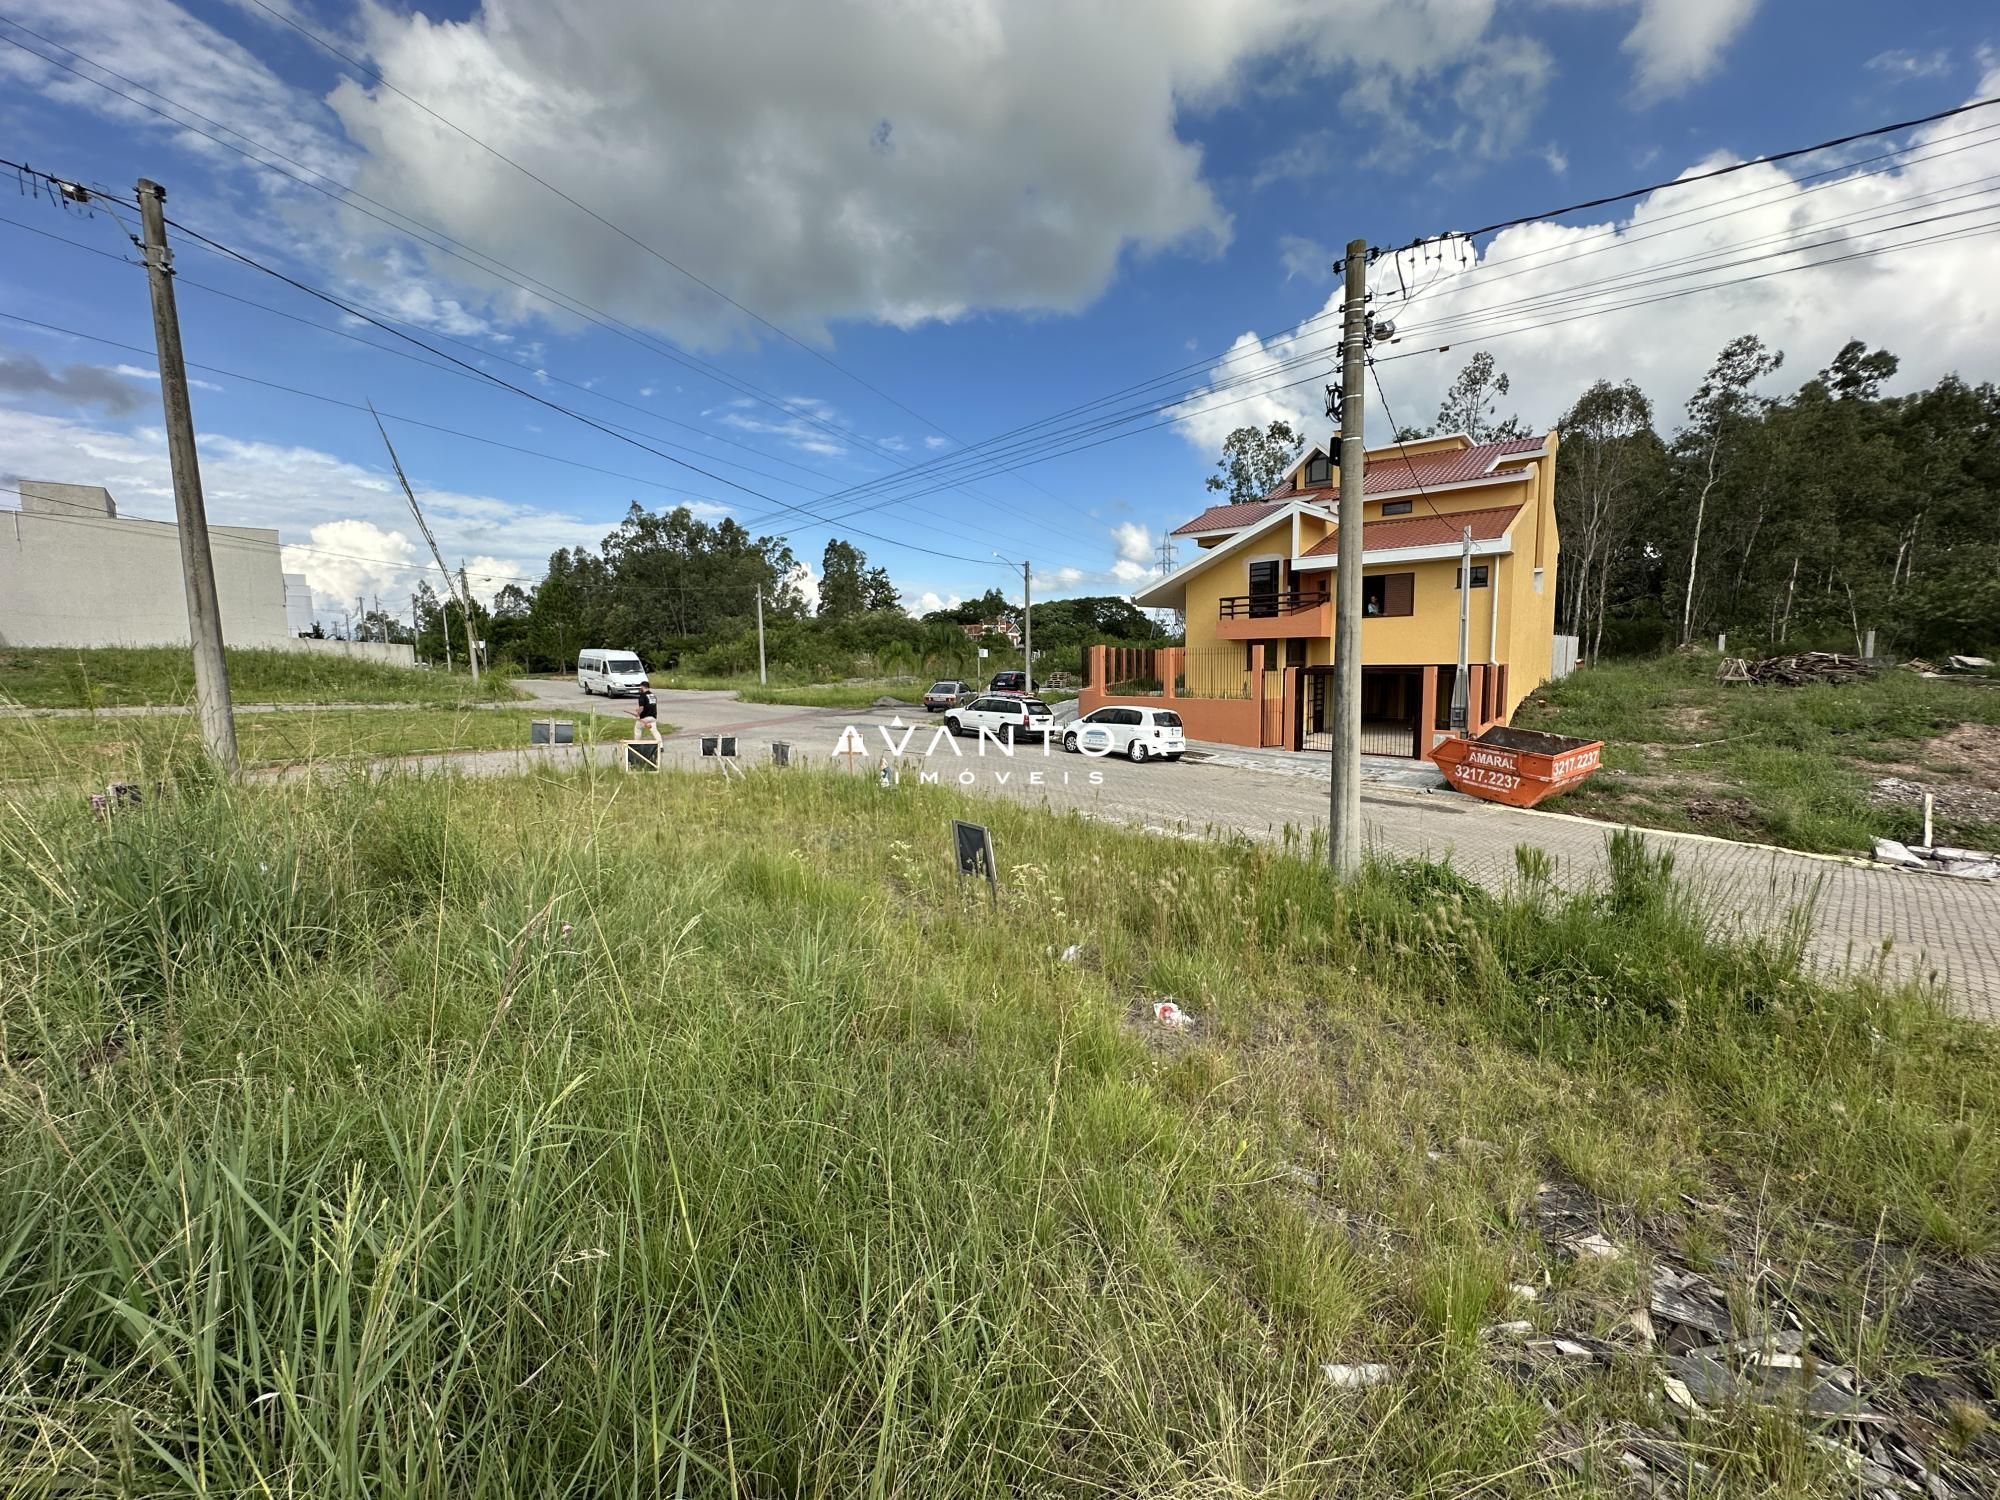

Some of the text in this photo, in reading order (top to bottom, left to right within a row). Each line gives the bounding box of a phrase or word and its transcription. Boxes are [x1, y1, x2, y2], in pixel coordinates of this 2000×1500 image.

[1469, 752, 1517, 770] AMARAL
[1553, 750, 1599, 776] 3217.2237
[1455, 764, 1521, 790] 3217.2237
